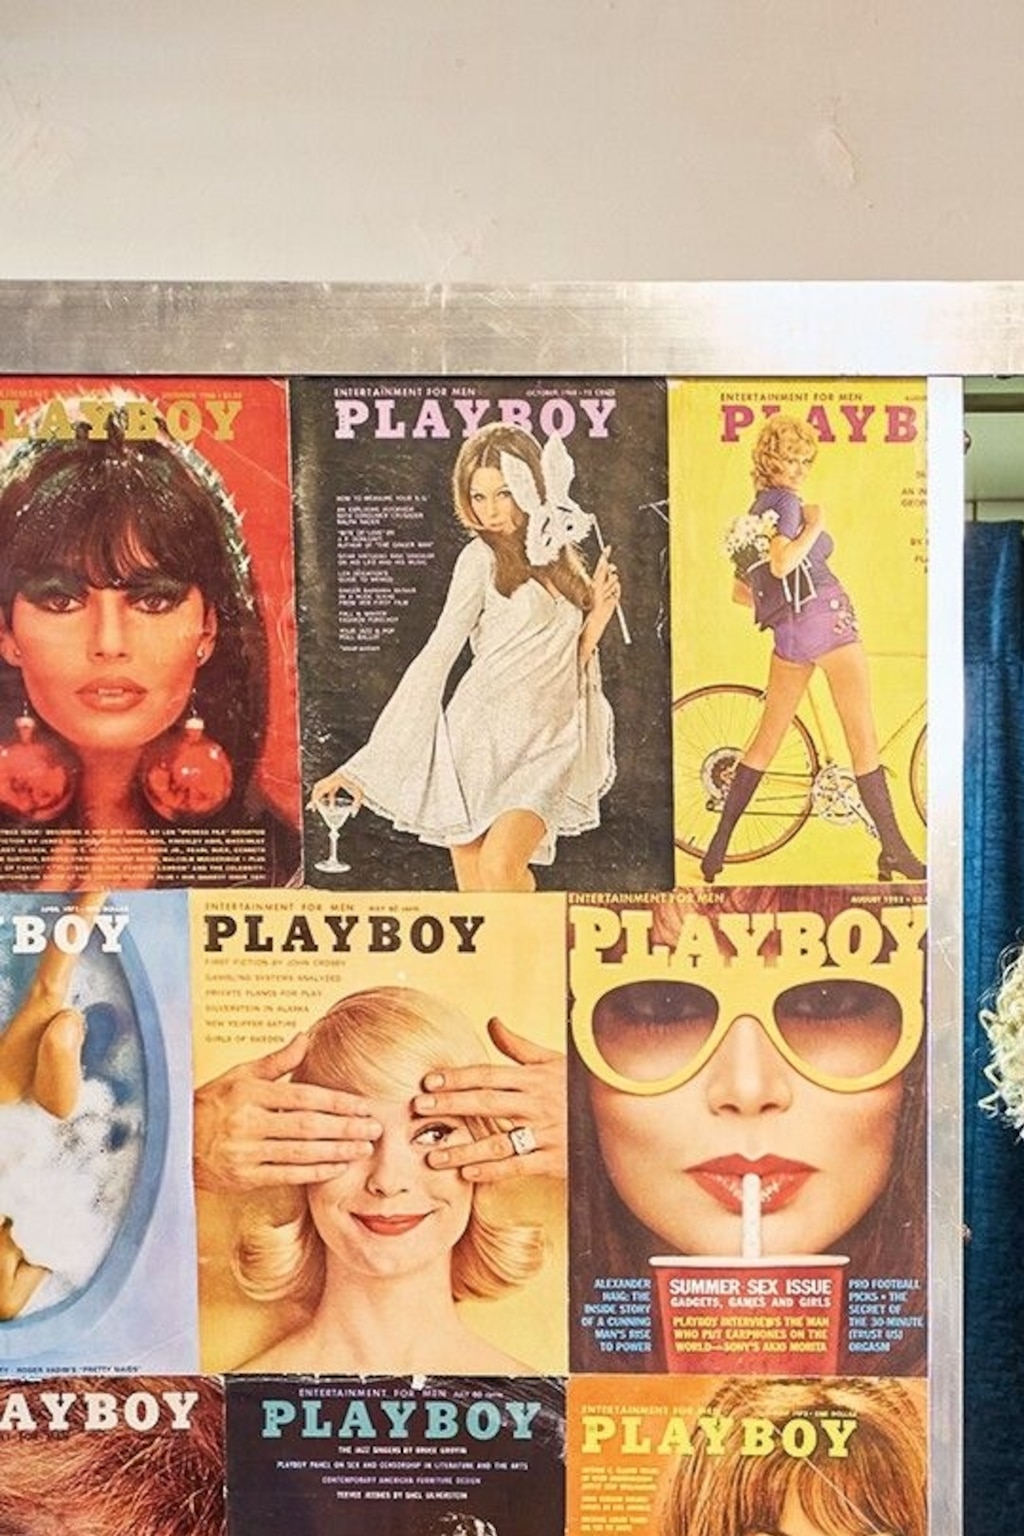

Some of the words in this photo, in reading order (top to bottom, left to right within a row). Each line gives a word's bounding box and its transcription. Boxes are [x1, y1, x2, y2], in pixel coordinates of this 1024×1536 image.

[721, 393, 808, 401] ENTERTAINMENT
[813, 393, 834, 401] FOR
[839, 393, 862, 401] MEN
[334, 399, 616, 439] PLAYBOY
[721, 405, 918, 443] PAYB
[569, 893, 667, 903] ENTERTAINMENT
[669, 893, 695, 903] FOR
[697, 893, 725, 903] MEN
[205, 903, 293, 911] ENTERTAINMENT
[301, 903, 322, 911] FOR
[330, 903, 354, 911] MEN
[0, 915, 129, 953] BOY
[204, 915, 485, 953] PLAYBOY
[569, 906, 928, 967] PLAYBOY
[593, 1279, 651, 1289] ALEXANDER
[669, 1279, 741, 1295] SUMMER
[747, 1279, 778, 1295] SEX
[786, 1279, 832, 1295] ISSUE
[849, 1279, 869, 1289] PRO
[872, 1279, 921, 1289] FOOTBALL
[670, 1297, 723, 1308] GADGETS,
[728, 1297, 766, 1308] GAMES
[771, 1297, 794, 1308] AND
[799, 1297, 831, 1308] GIRLS
[584, 1304, 616, 1314] INSIDE
[619, 1304, 651, 1314] STORY
[673, 1316, 718, 1327] PLAYBOY
[720, 1316, 782, 1327] INTERVIEWS
[785, 1316, 803, 1327] THE
[806, 1316, 830, 1327] MAN
[674, 1329, 699, 1339] WHO
[702, 1329, 723, 1339] PUT
[725, 1329, 787, 1339] EARPHONES
[790, 1329, 805, 1339] ON
[808, 1329, 828, 1339] THE
[600, 1342, 613, 1352] TO
[616, 1342, 651, 1352] POWER
[849, 1342, 890, 1352] ORGASM
[299, 1389, 387, 1397] ENTERTAINMENT
[394, 1389, 415, 1397] FOR
[422, 1389, 447, 1397] MEN
[262, 1400, 542, 1441] PLAYBOY
[581, 1416, 857, 1458] PLAYBOY
